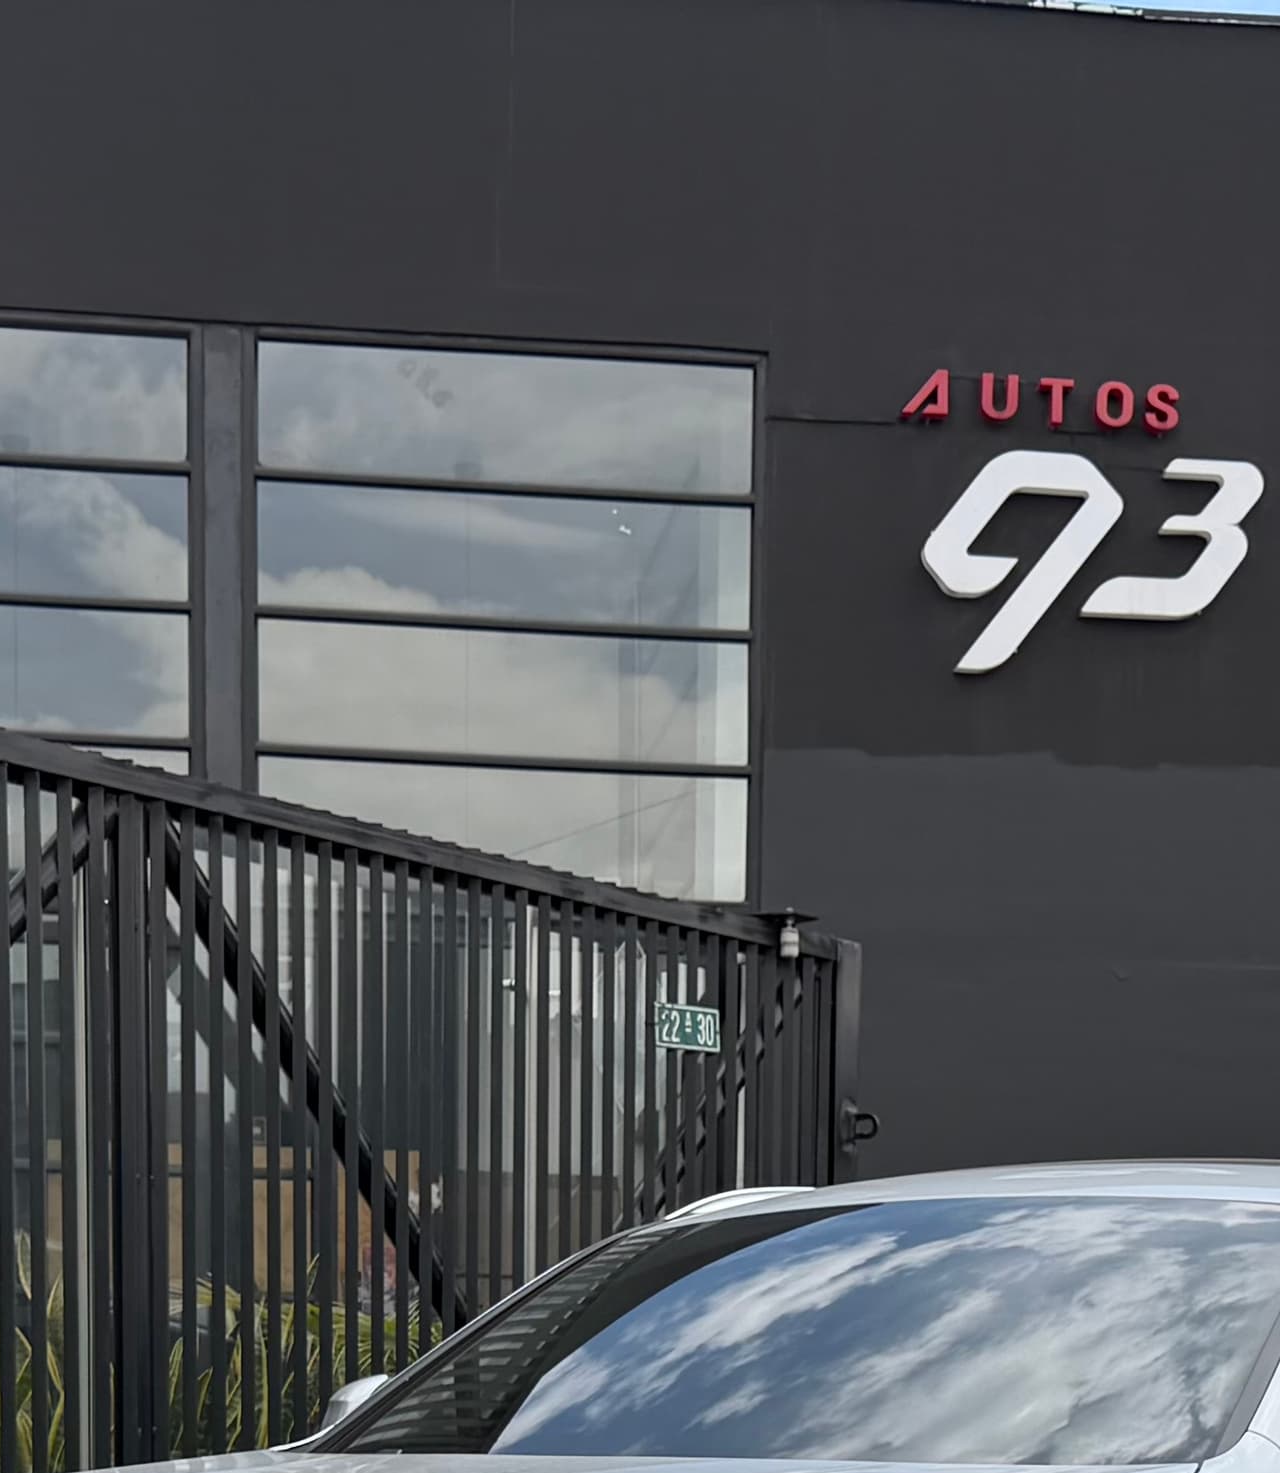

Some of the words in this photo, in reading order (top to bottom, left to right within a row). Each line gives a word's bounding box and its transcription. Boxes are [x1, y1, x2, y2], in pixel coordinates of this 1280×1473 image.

[900, 369, 1180, 434] AUTOS
[921, 450, 1265, 674] 93
[661, 1010, 680, 1042] 22
[697, 1013, 714, 1046] 30
